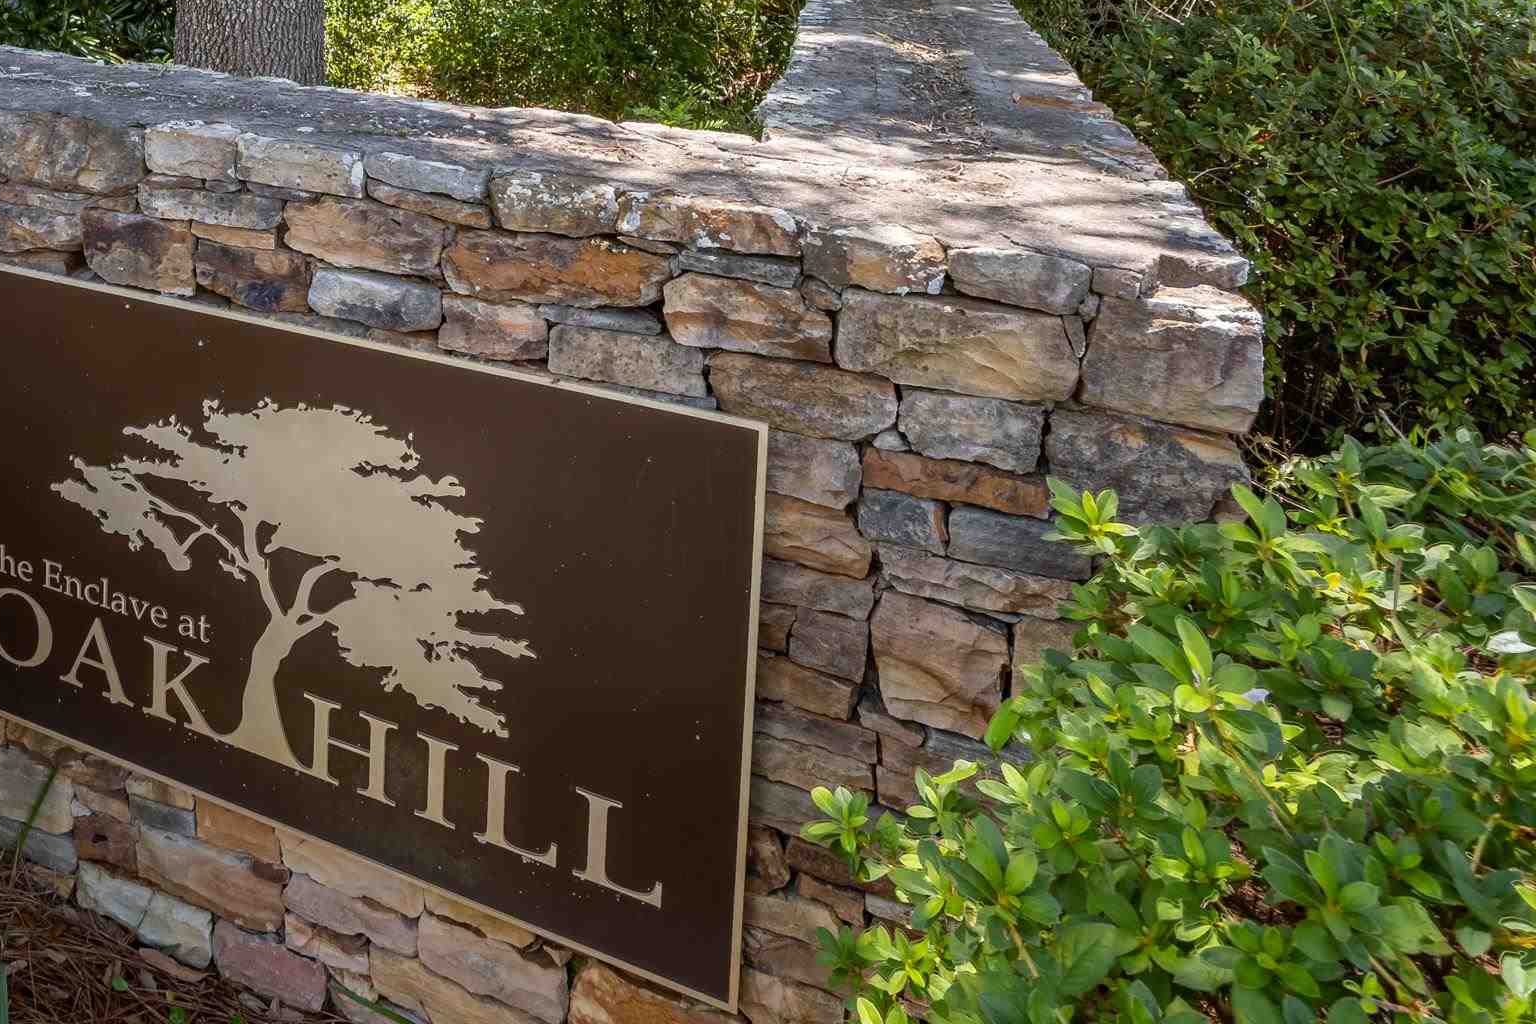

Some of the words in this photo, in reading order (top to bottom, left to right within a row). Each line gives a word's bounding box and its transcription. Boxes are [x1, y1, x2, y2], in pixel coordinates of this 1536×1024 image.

[41, 558, 169, 628] Enclave
[178, 613, 212, 643] at
[302, 690, 663, 909] HILL
